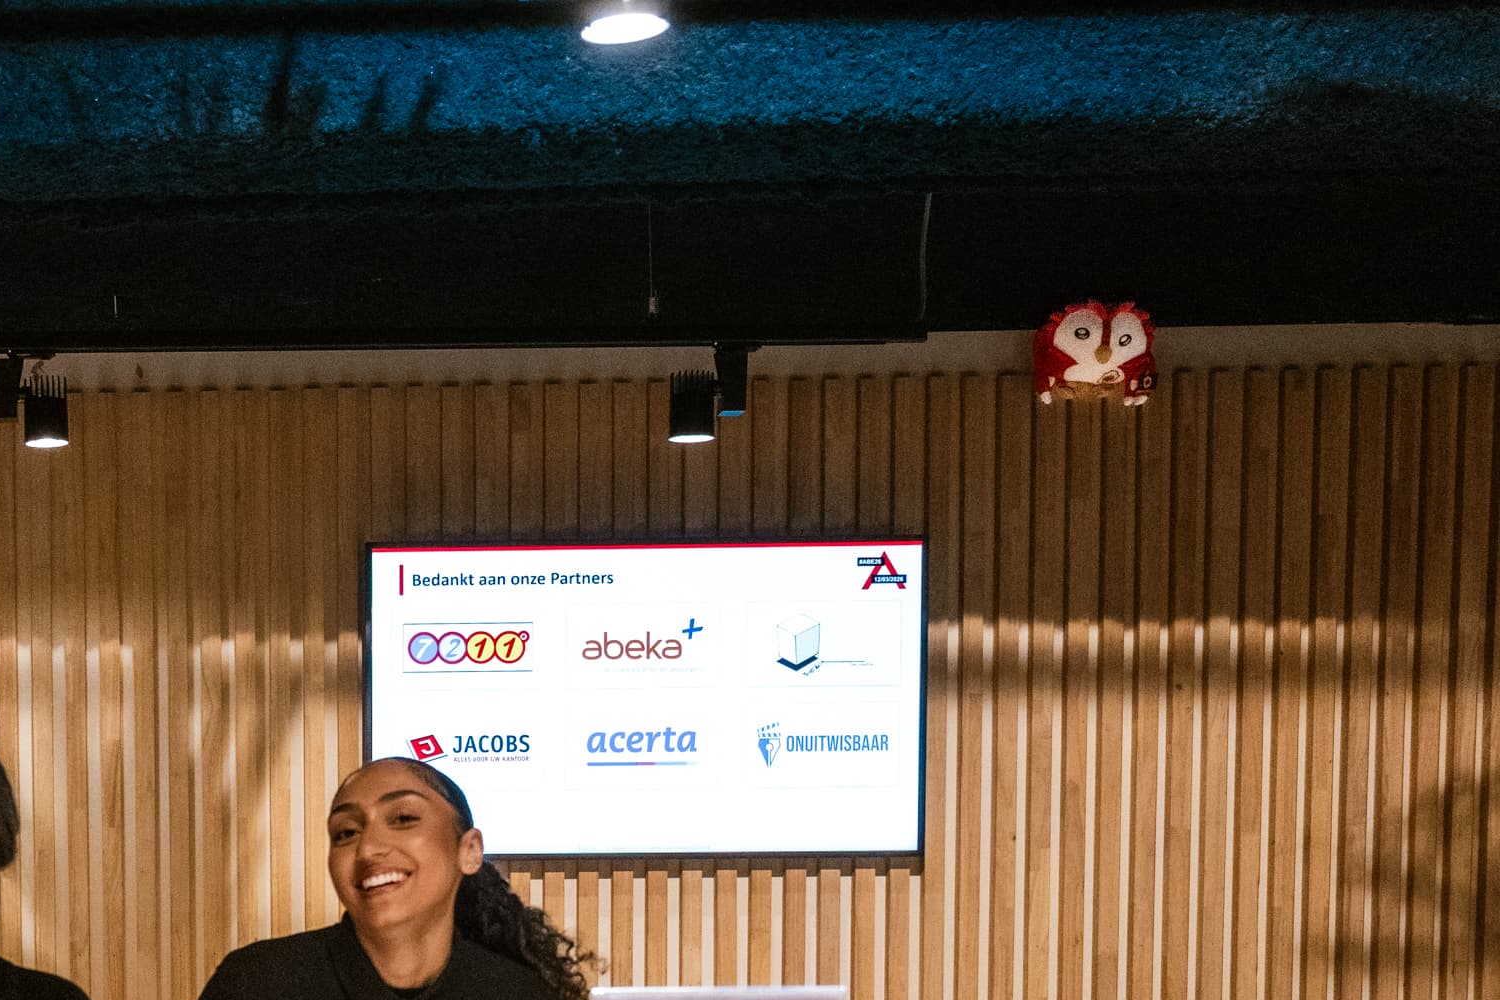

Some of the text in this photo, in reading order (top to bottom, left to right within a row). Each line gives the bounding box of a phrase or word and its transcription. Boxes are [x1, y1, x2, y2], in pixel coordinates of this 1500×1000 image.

[411, 572, 614, 587] Bedankt aan onze Partners
[452, 734, 531, 754] JACOBS
[586, 727, 698, 753] acerta
[785, 734, 889, 752] ONUITWISBAAR
